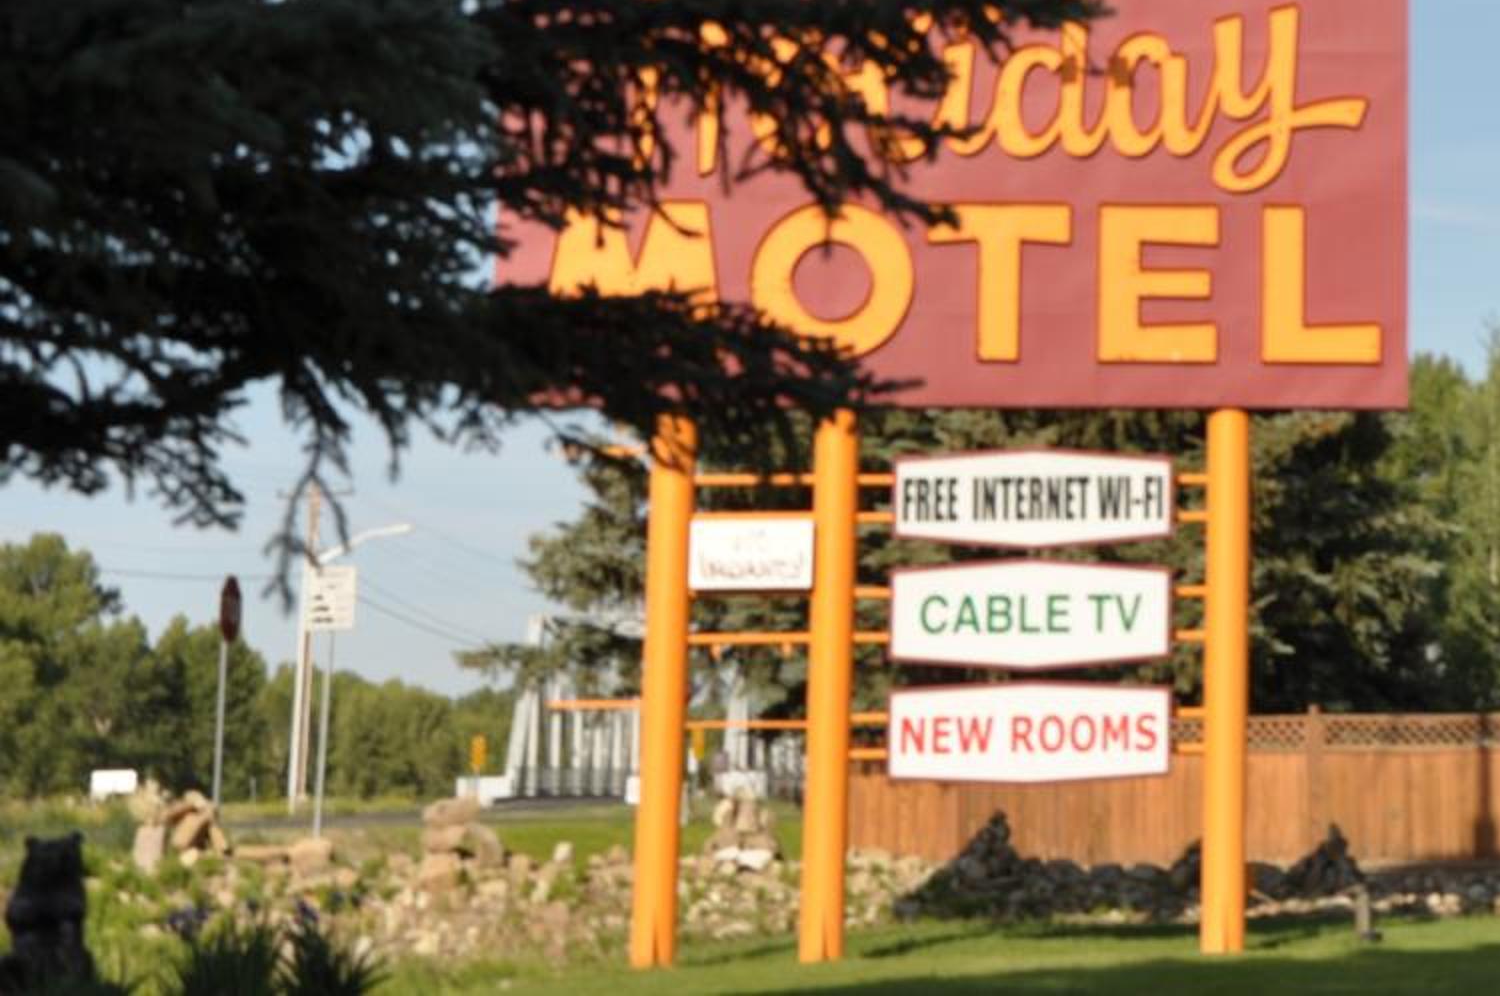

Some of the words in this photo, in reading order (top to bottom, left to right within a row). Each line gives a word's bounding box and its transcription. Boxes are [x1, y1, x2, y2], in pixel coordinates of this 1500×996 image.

[547, 201, 1383, 364] MOTEL
[902, 477, 959, 522] FREE
[973, 476, 1090, 521] INTERNET
[1098, 476, 1165, 520] WI-FI
[919, 595, 1071, 634] CABLE
[1087, 594, 1142, 633] TV
[899, 717, 994, 755] NEW
[1010, 714, 1158, 753] ROOMS
